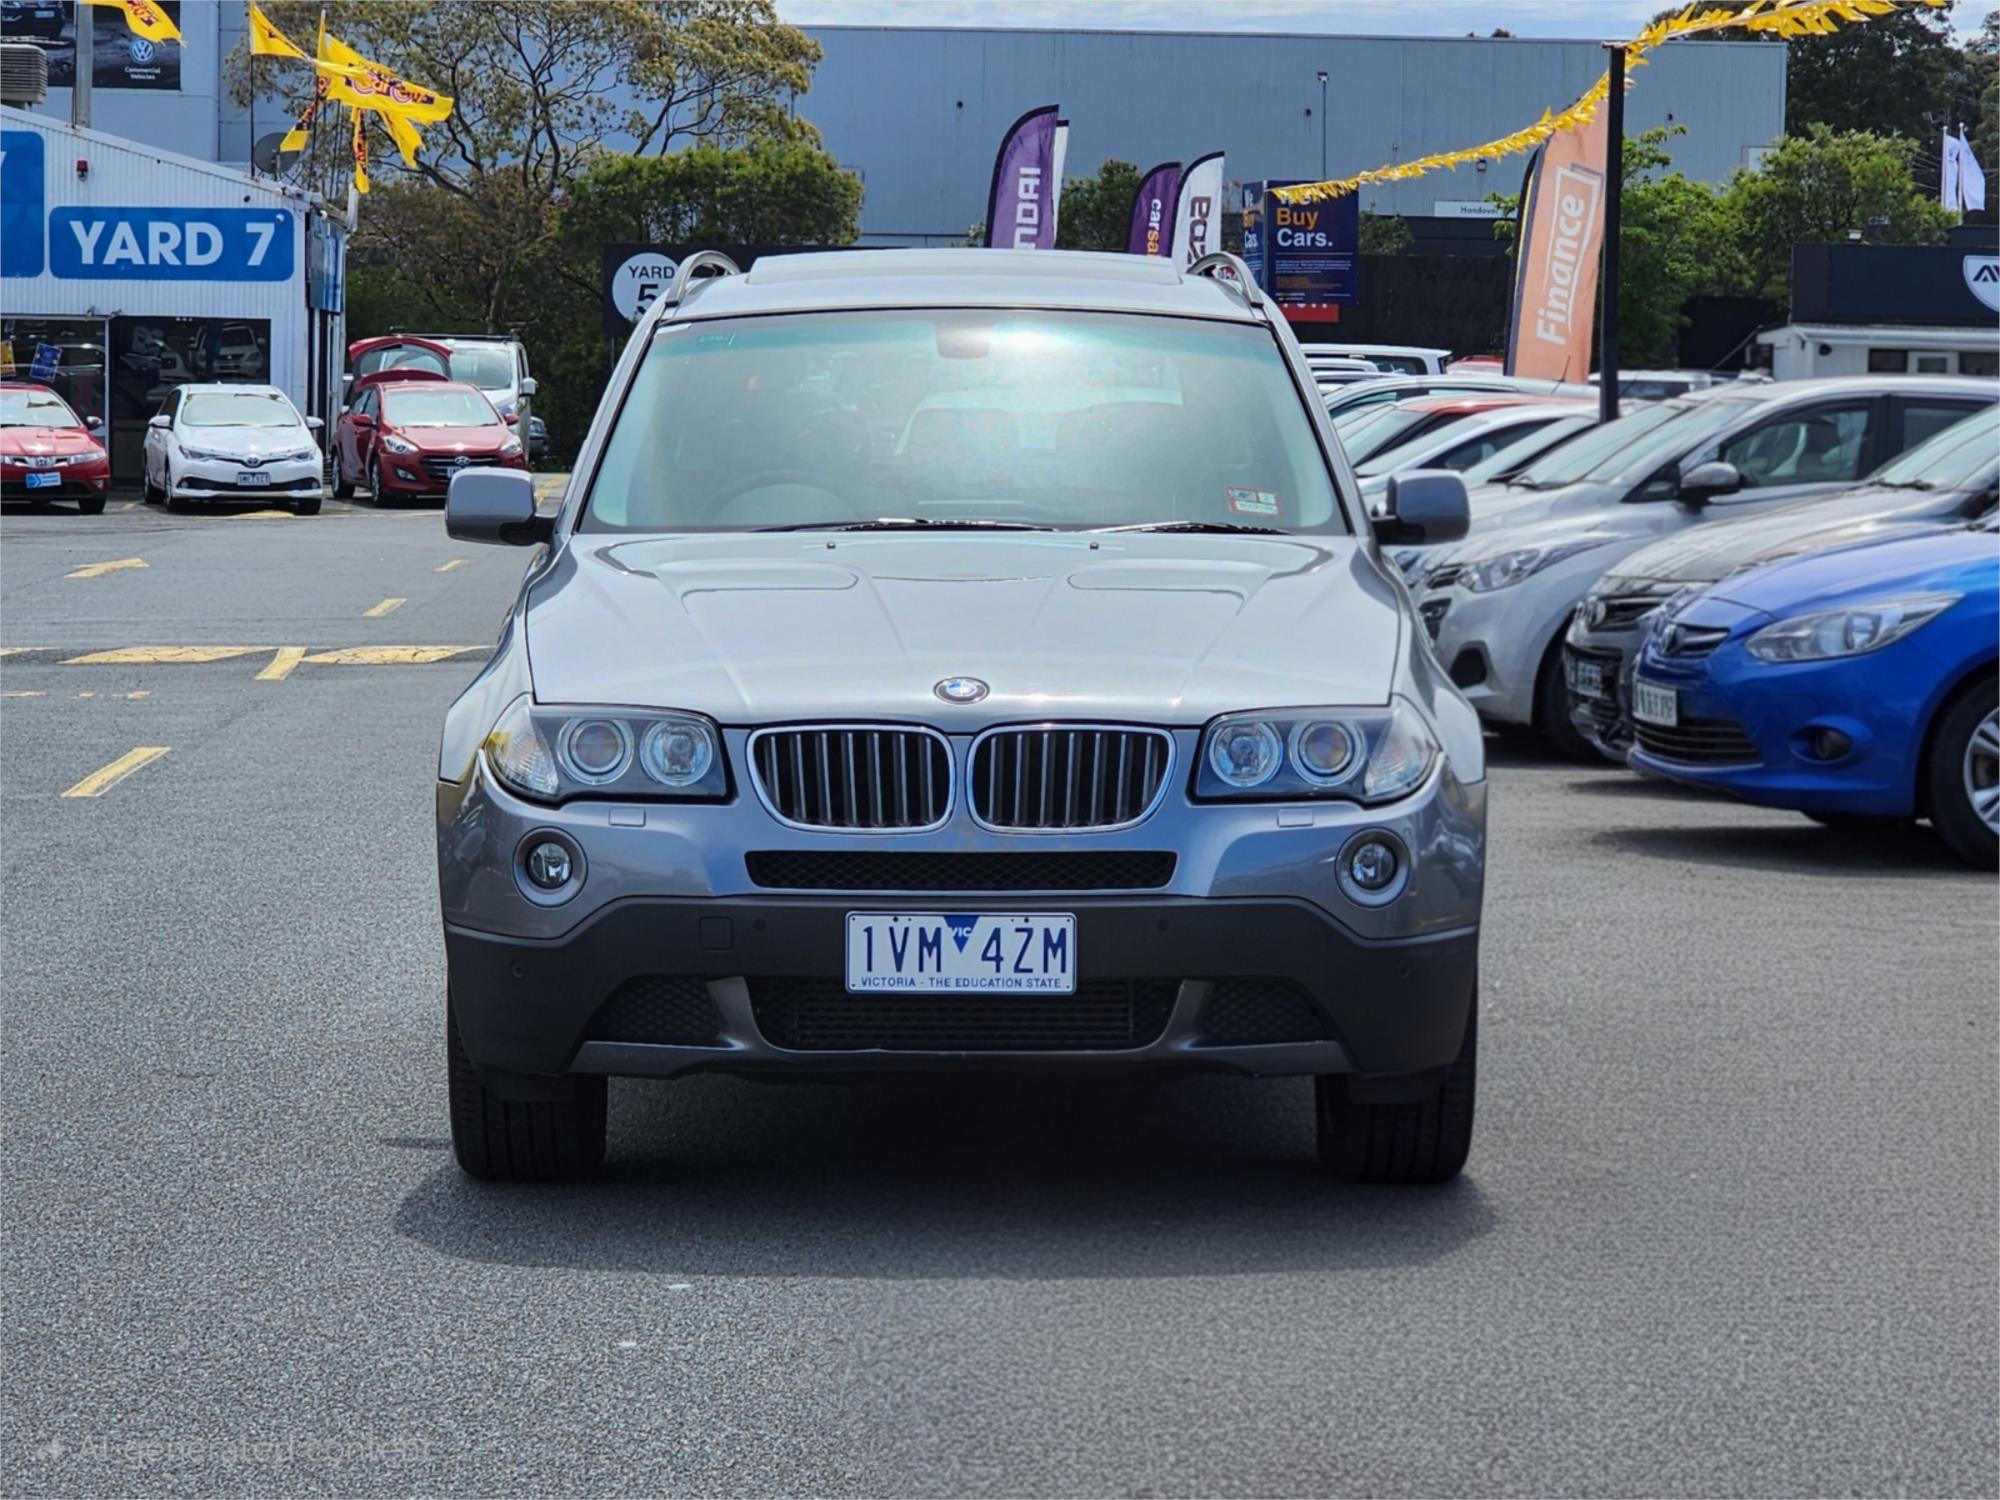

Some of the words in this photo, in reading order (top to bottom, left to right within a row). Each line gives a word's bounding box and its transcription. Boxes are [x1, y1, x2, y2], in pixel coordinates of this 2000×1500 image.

[1147, 198, 1162, 256] carsa
[1276, 207, 1318, 230] Buy
[69, 220, 224, 266] YARD
[245, 222, 276, 266] 7
[1276, 228, 1333, 247] Cars.
[628, 265, 675, 279] YARD
[1535, 193, 1586, 346] Finance
[635, 284, 658, 314] 5
[949, 926, 972, 938] VIC
[862, 925, 943, 973] 1VM
[980, 926, 1068, 974] 4ZM
[861, 976, 916, 988] VICTORIA
[928, 977, 951, 988] THE
[955, 977, 1023, 989] EDUCATION
[1026, 978, 1062, 989] STATE
